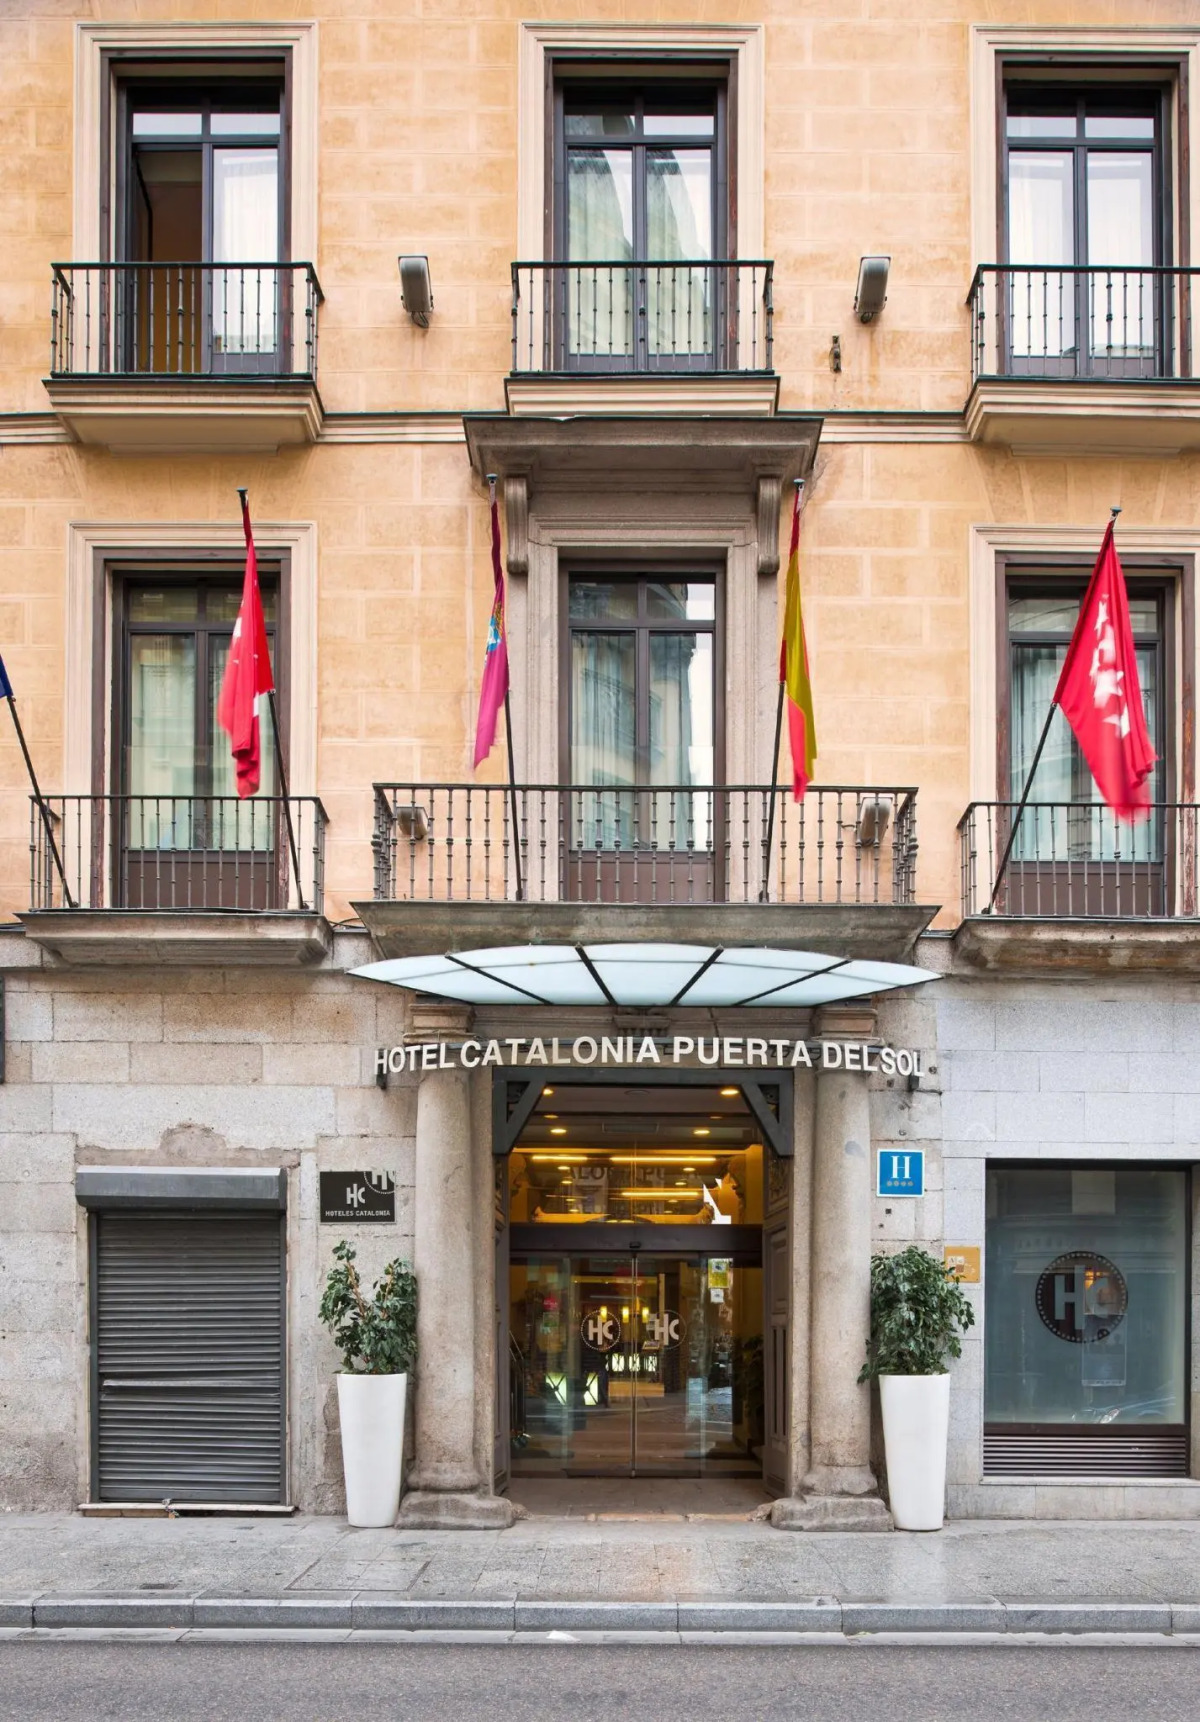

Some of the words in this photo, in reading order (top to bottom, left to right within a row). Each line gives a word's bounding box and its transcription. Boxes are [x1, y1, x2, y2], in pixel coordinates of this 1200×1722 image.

[374, 1042, 455, 1075] HOTEL
[460, 1036, 661, 1068] CATALONIA
[673, 1036, 813, 1068] PUERTA
[822, 1041, 878, 1072] DEL
[881, 1047, 925, 1077] SOL
[891, 1155, 911, 1179] H
[346, 1183, 366, 1208] HC
